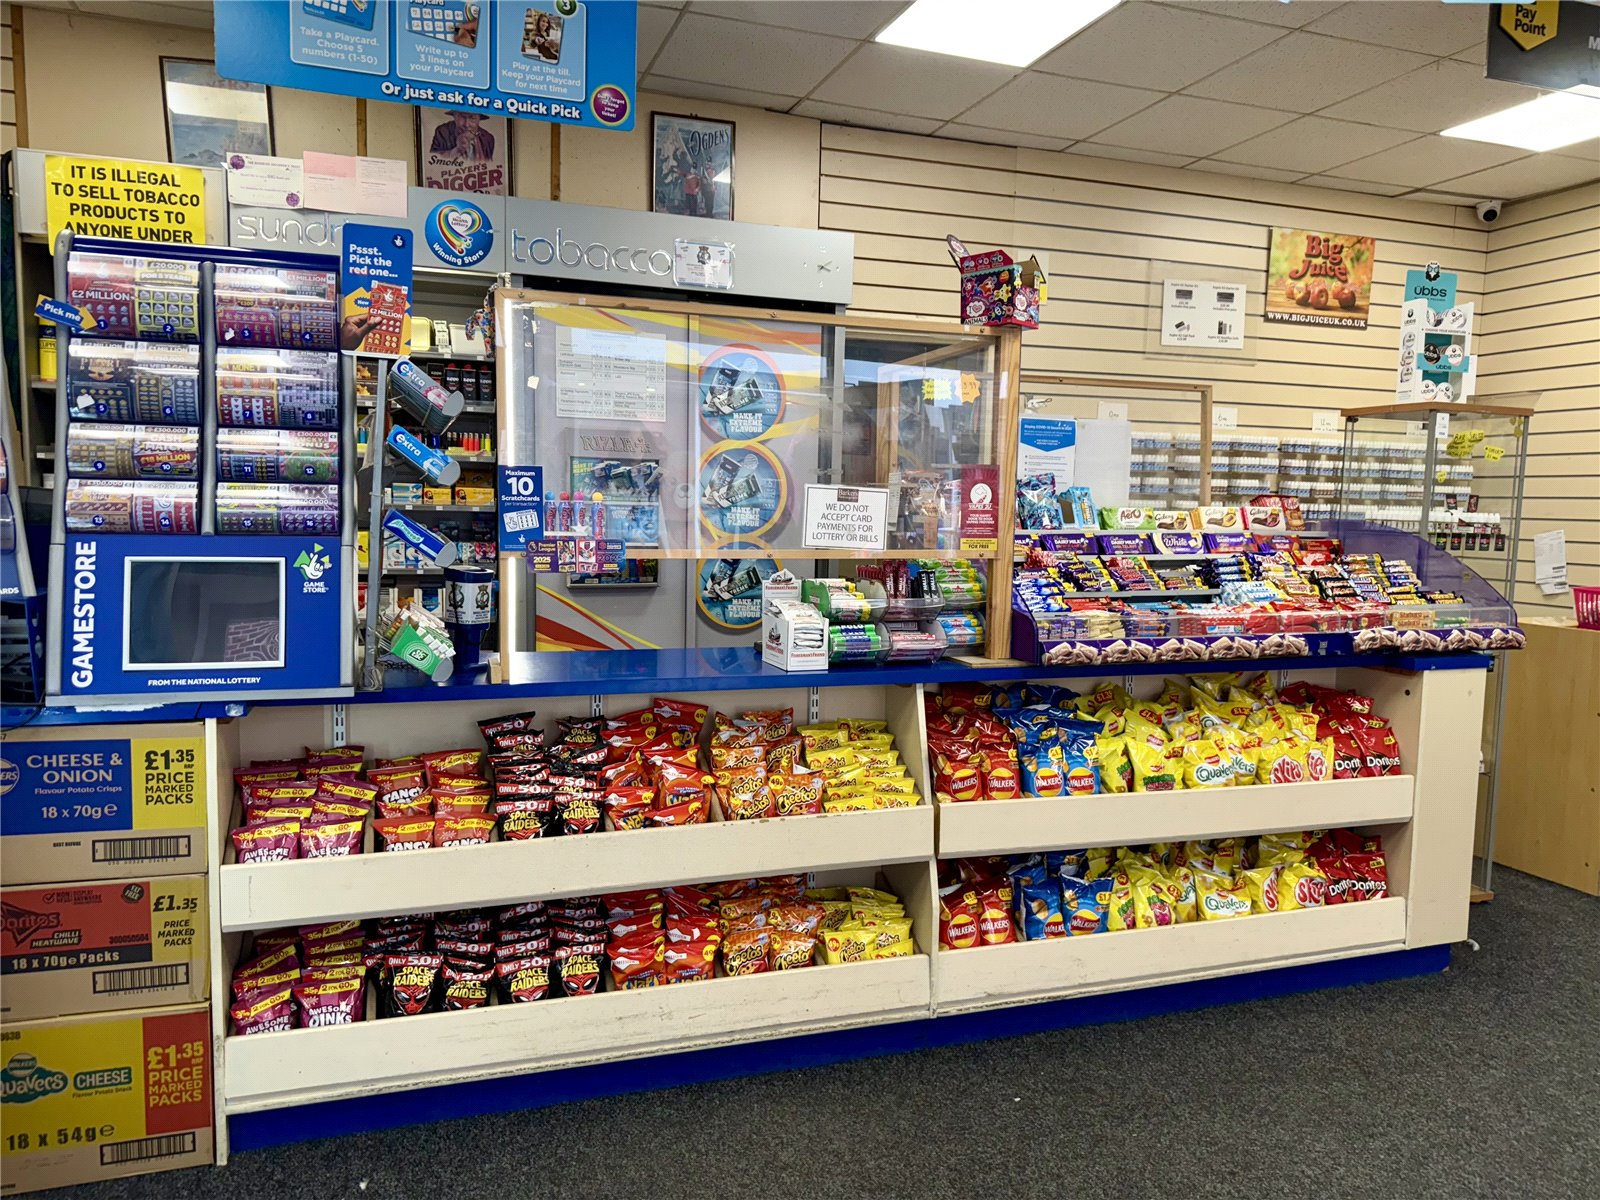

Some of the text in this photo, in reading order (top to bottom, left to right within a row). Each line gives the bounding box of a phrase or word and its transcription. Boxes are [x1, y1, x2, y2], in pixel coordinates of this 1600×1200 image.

[1516, 4, 1537, 23] Pay
[300, 26, 323, 38] Take
[1514, 18, 1546, 36] Point
[316, 39, 363, 53] Choose 5
[415, 44, 469, 59] Write up to
[302, 47, 378, 66] numbers (1-50)
[428, 55, 465, 68] lines on
[410, 63, 474, 79] your Playcard
[512, 61, 556, 74] Play at the
[502, 69, 581, 87] Keep your Playcard
[515, 80, 568, 94] for next time
[381, 81, 581, 119] Or just ask for a Quick Pick
[428, 155, 464, 167] Smoke
[71, 165, 181, 188] IT IS ILLEGAL
[441, 163, 488, 178] PLAYER'S
[51, 182, 200, 207] TO SELL TOBACCO
[69, 203, 185, 225] PRODUCTS TO
[452, 217, 469, 225] Health
[237, 212, 348, 248] sundr
[451, 221, 468, 229] Lottery
[64, 221, 193, 244] ANYONE UNDER
[349, 244, 382, 255] Pssst.
[433, 242, 484, 265] Winning Store
[512, 228, 674, 276] tobacco
[1305, 235, 1344, 265] Big
[349, 254, 392, 267] Pick the
[349, 266, 398, 278] red one...
[1289, 259, 1348, 283] Juice
[72, 290, 129, 301] £2 MILLION
[44, 303, 81, 321] Pick me
[377, 309, 403, 320] MILLION
[1267, 312, 1366, 328] WWW.BIGJUICEUK.CO.UK
[399, 363, 426, 388] extra
[395, 433, 422, 457] extra
[507, 477, 534, 495] 10
[820, 513, 873, 522] ACCEPT CARD
[817, 522, 857, 532] PAYMENTS
[812, 532, 878, 543] LOTTERY OR BILLS
[71, 541, 97, 688] GAMESTORE
[148, 679, 171, 687] FROM
[187, 677, 227, 686] NATIONAL
[227, 676, 261, 685] LOTTERY
[26, 753, 123, 769] CHEESE &
[144, 749, 195, 771] £1.35
[1366, 755, 1400, 768] Doritos
[43, 769, 113, 784] ONION
[145, 772, 195, 784] PRICE
[952, 778, 977, 789] WALKERS
[989, 779, 1015, 788] WALKERS
[35, 787, 66, 795] Flavour
[96, 785, 123, 793] Crisps
[145, 785, 194, 794] MARKED
[382, 788, 422, 802] TANGY
[145, 794, 194, 806] PACKS
[496, 801, 549, 812] ONLY 50p!
[568, 800, 594, 809] SPACE
[776, 788, 817, 814] Cheetos
[41, 806, 70, 819] 18 x
[510, 810, 536, 819] SPACE
[563, 807, 600, 820] RAIDERS
[503, 818, 542, 833] RAIDERS
[386, 841, 430, 852] TANGY
[244, 848, 290, 860] AWESOME
[1351, 879, 1387, 891] Doritos
[153, 895, 198, 913] £1.35
[1205, 895, 1249, 911] Quavers
[164, 920, 190, 929] PRICE
[54, 931, 79, 939] CHILLI
[157, 929, 195, 939] MARKED
[32, 938, 80, 948] HEATWAVE
[163, 937, 193, 948] PACKS
[12, 951, 120, 970] 18 Packs
[388, 957, 406, 965] ONLY
[401, 967, 430, 975] SPACE
[308, 1011, 352, 1028] OINKS
[147, 1041, 204, 1070] £1.35
[75, 1069, 129, 1088] CHEESE
[149, 1066, 203, 1084] PRICE
[149, 1081, 203, 1095] MARKED
[149, 1090, 202, 1107] PACKS
[6, 1133, 48, 1151] 18 x
